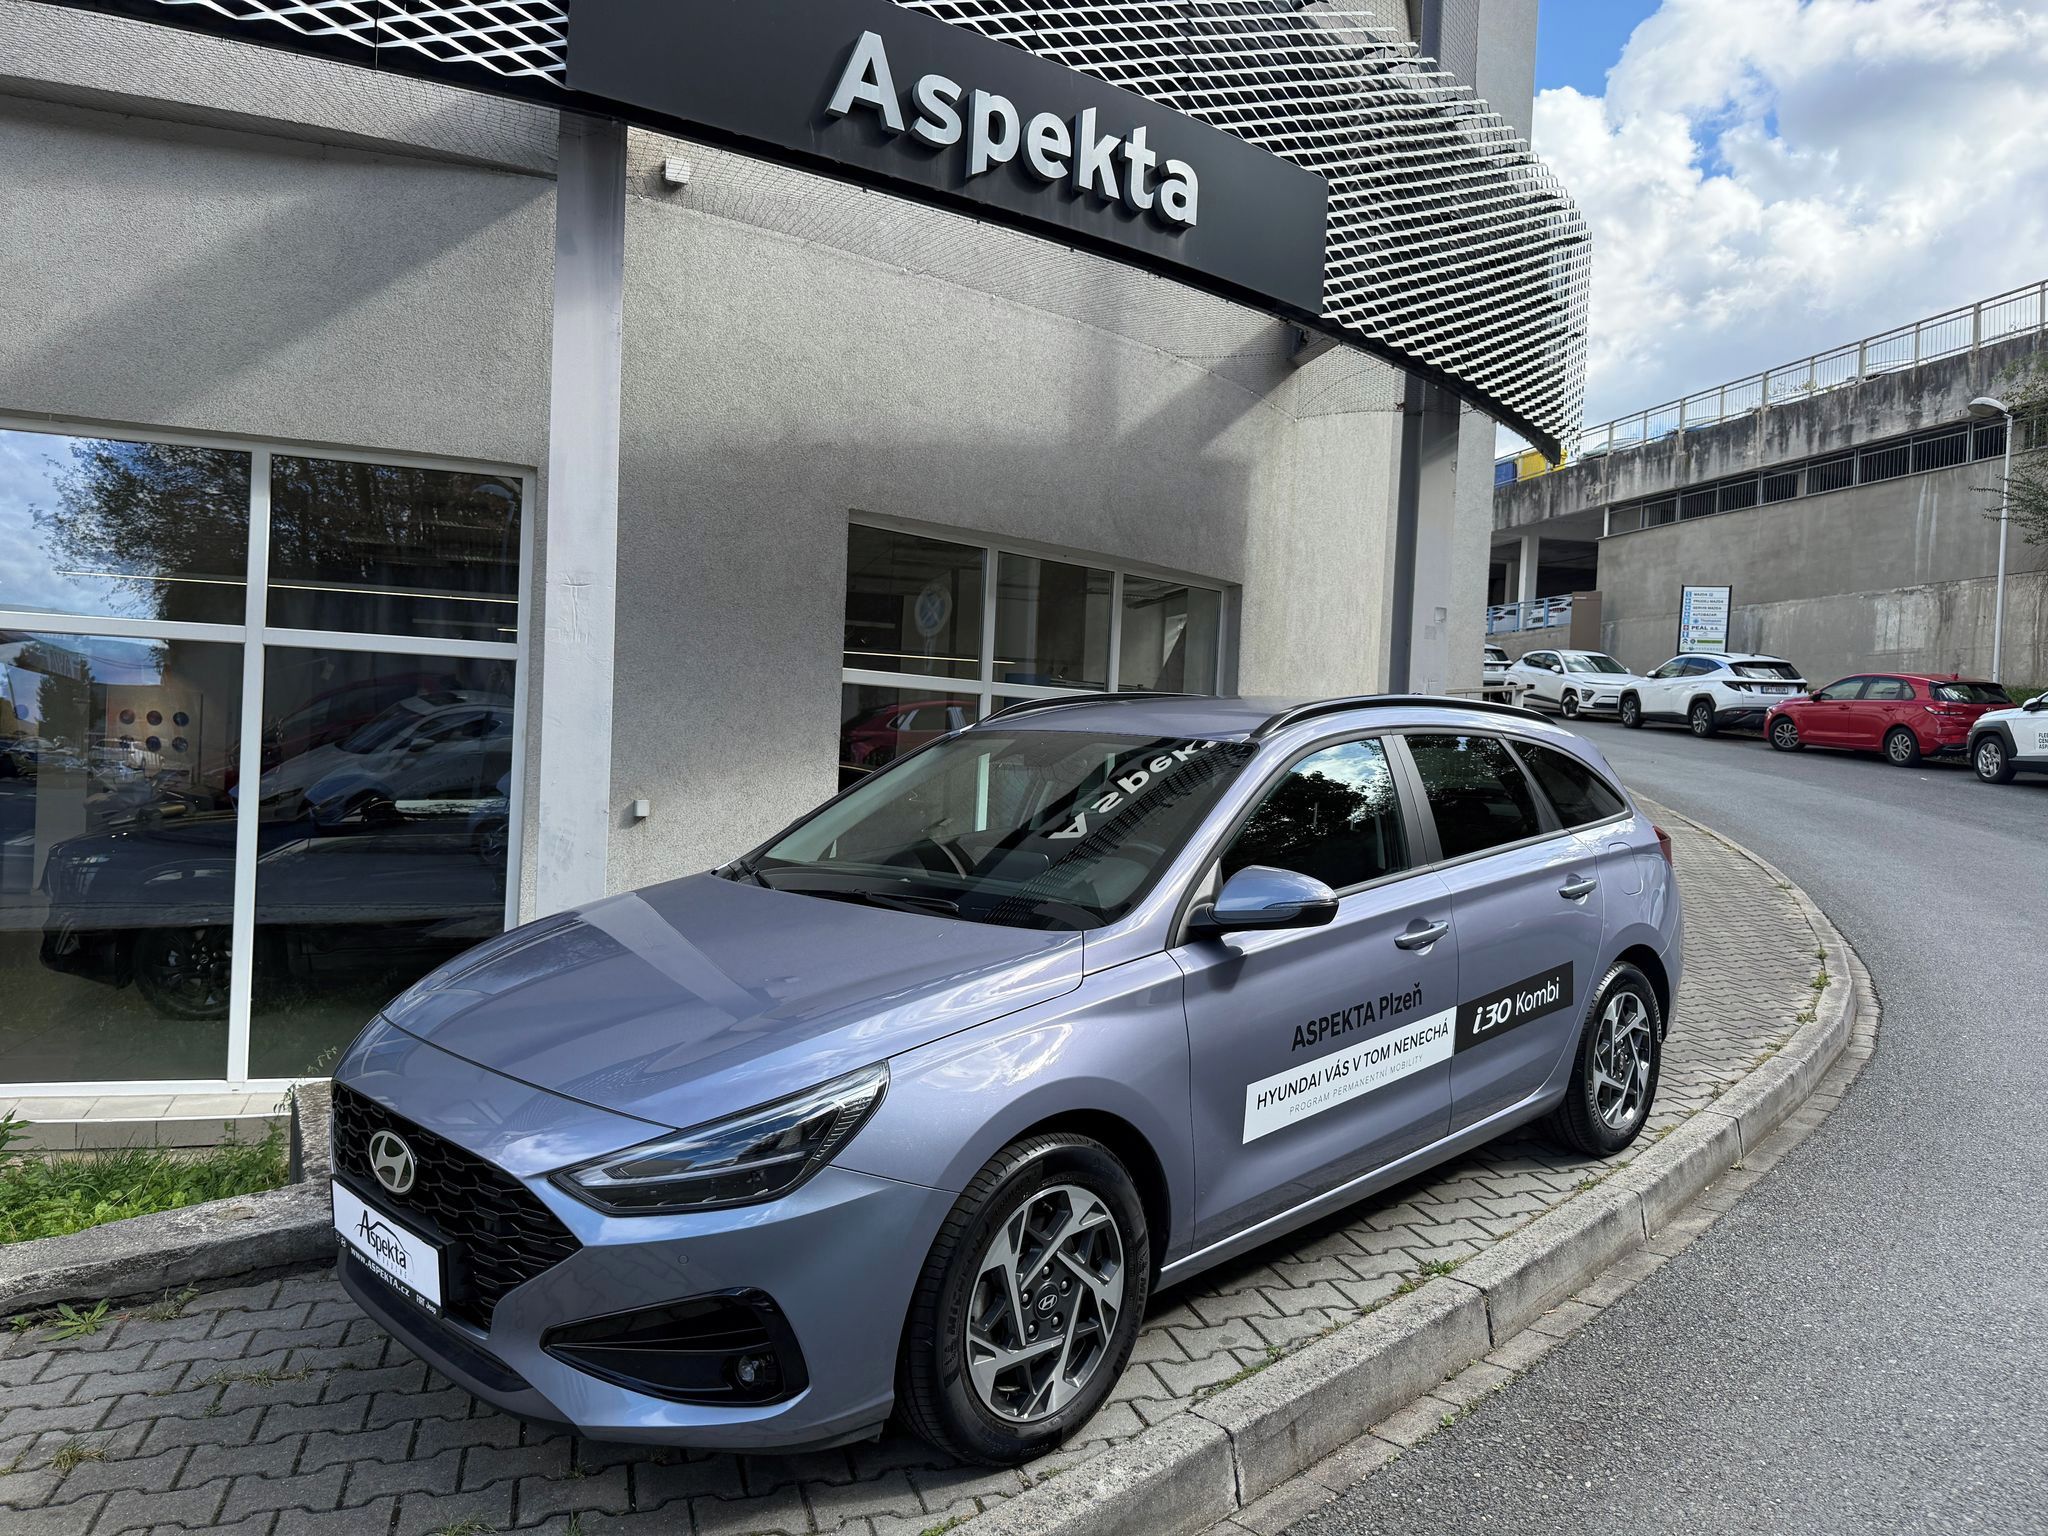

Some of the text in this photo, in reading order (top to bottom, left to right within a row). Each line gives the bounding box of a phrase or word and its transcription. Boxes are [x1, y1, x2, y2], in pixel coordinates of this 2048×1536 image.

[825, 30, 1198, 227] Aspekta
[1291, 982, 1423, 1051] ASPEKTA Plzeň
[1472, 976, 1559, 1035] i30 Kombi
[1256, 1017, 1449, 1110] HYUNDAI VÁS V TOM NENECHÁ
[1289, 1054, 1424, 1116] PROGRAM PERMANENTNÍ MOBILITY
[358, 1208, 407, 1270] Aspekta
[350, 1246, 411, 1297] www.ASPEKTA.cz
